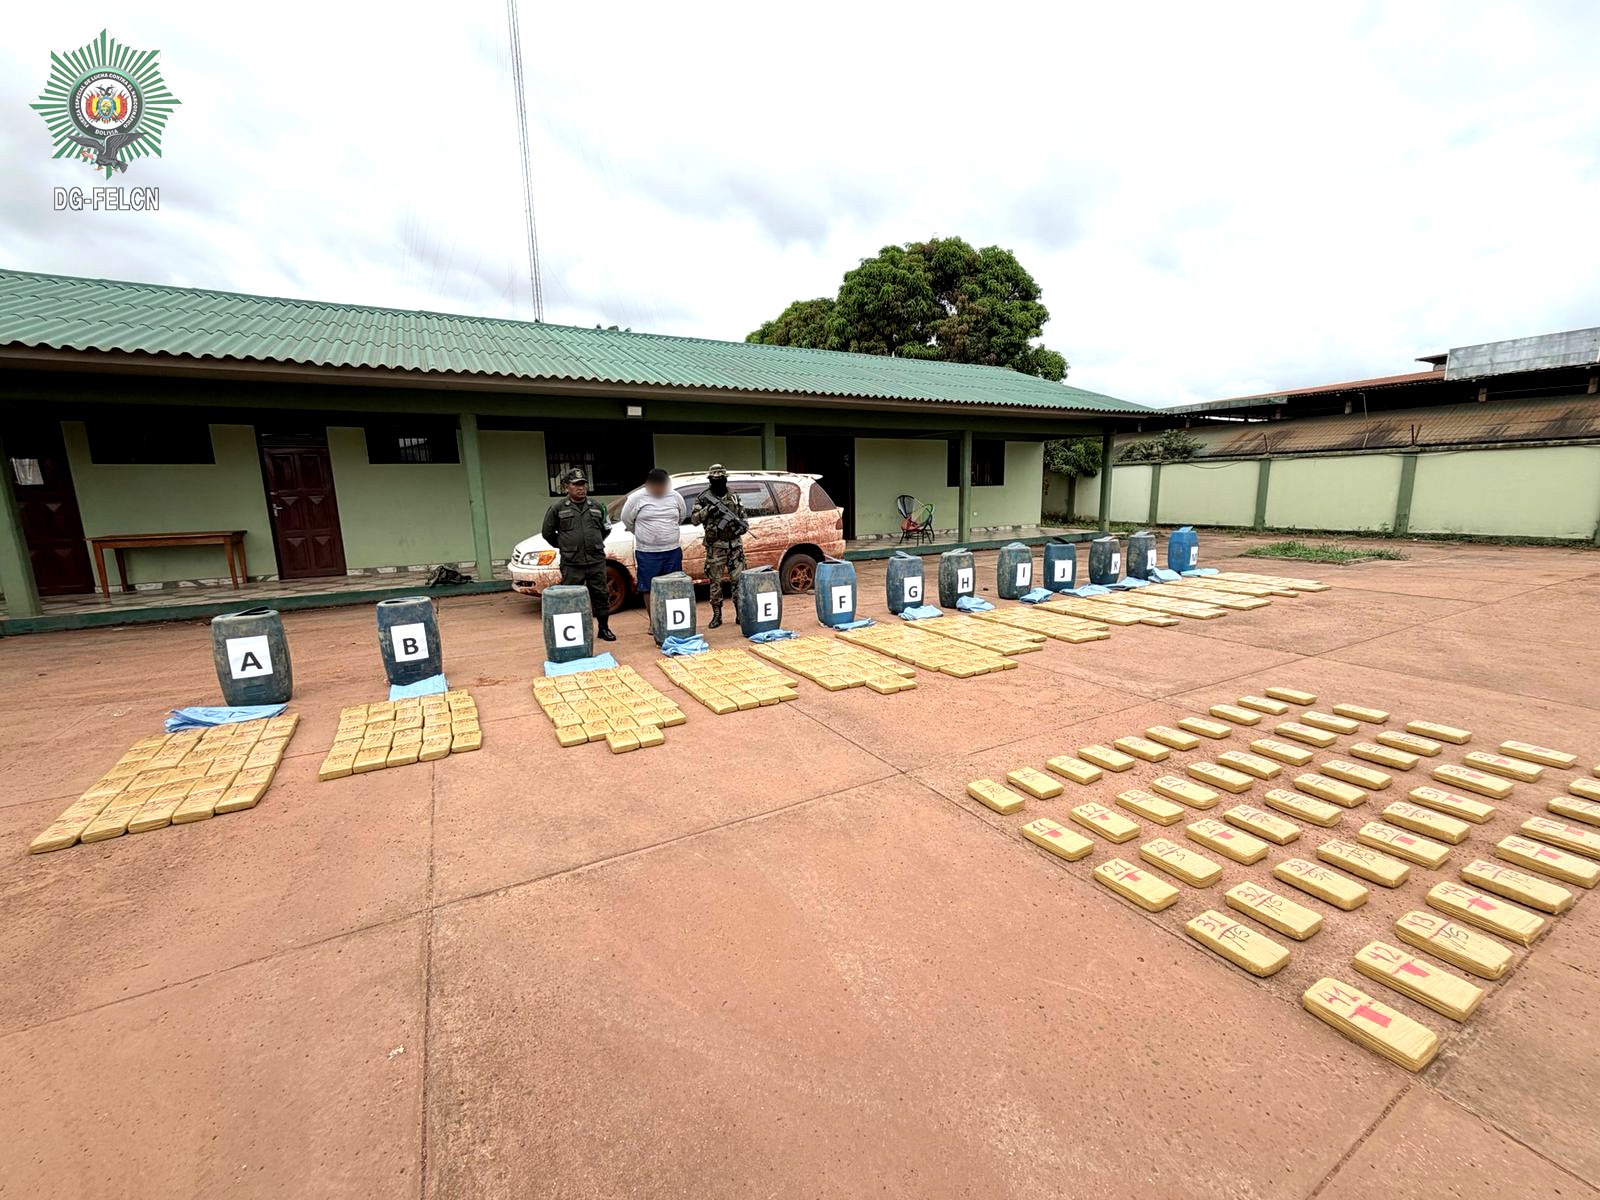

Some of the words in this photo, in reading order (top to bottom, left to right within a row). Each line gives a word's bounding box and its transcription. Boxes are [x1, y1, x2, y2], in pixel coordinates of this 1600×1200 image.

[1060, 568, 1066, 579] J
[961, 577, 970, 589] H
[908, 586, 918, 598] G
[839, 595, 846, 609] F
[764, 603, 772, 617] E
[673, 610, 685, 625] D
[563, 625, 577, 641] C
[402, 637, 419, 656] B
[240, 651, 263, 672] A
[1080, 804, 1105, 817] 12
[1032, 820, 1054, 833] 11
[1197, 820, 1225, 834] 23
[1150, 841, 1178, 854] 22
[1102, 861, 1133, 876] 21
[1285, 860, 1310, 872] 33
[1237, 886, 1269, 902] 32
[1196, 914, 1227, 933] 31
[1405, 915, 1437, 931] 43
[1366, 946, 1402, 964] 42
[1318, 986, 1361, 1007] 41
